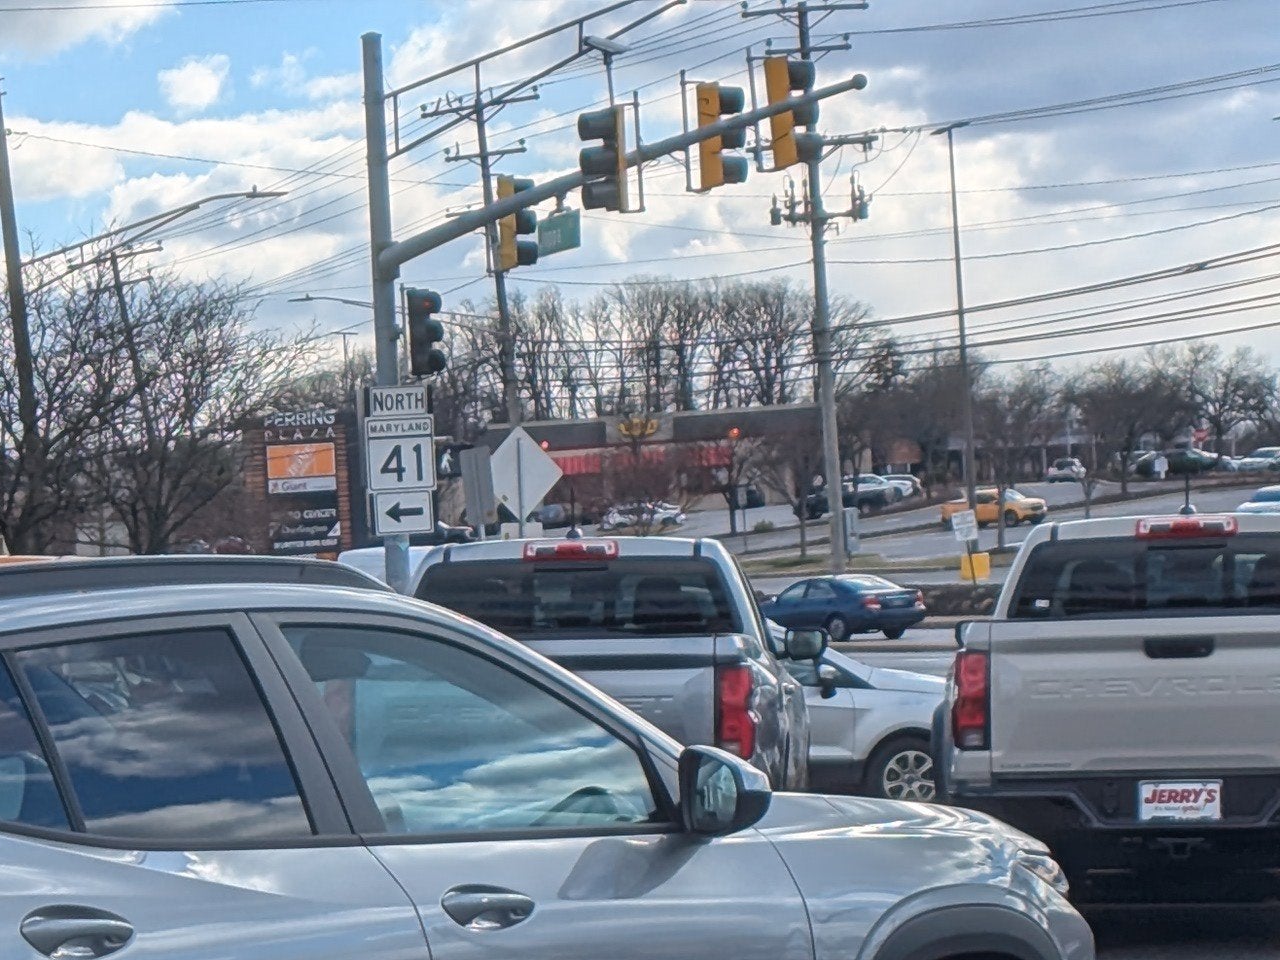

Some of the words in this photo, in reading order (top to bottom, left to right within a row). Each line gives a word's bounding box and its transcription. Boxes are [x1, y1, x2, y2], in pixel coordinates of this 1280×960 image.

[372, 392, 425, 411] NORTH
[263, 409, 337, 426] PERRING
[264, 427, 336, 441] PLAZA
[370, 422, 429, 433] MARYLAND
[380, 443, 424, 482] 41
[1144, 787, 1218, 804] JERRY'S
